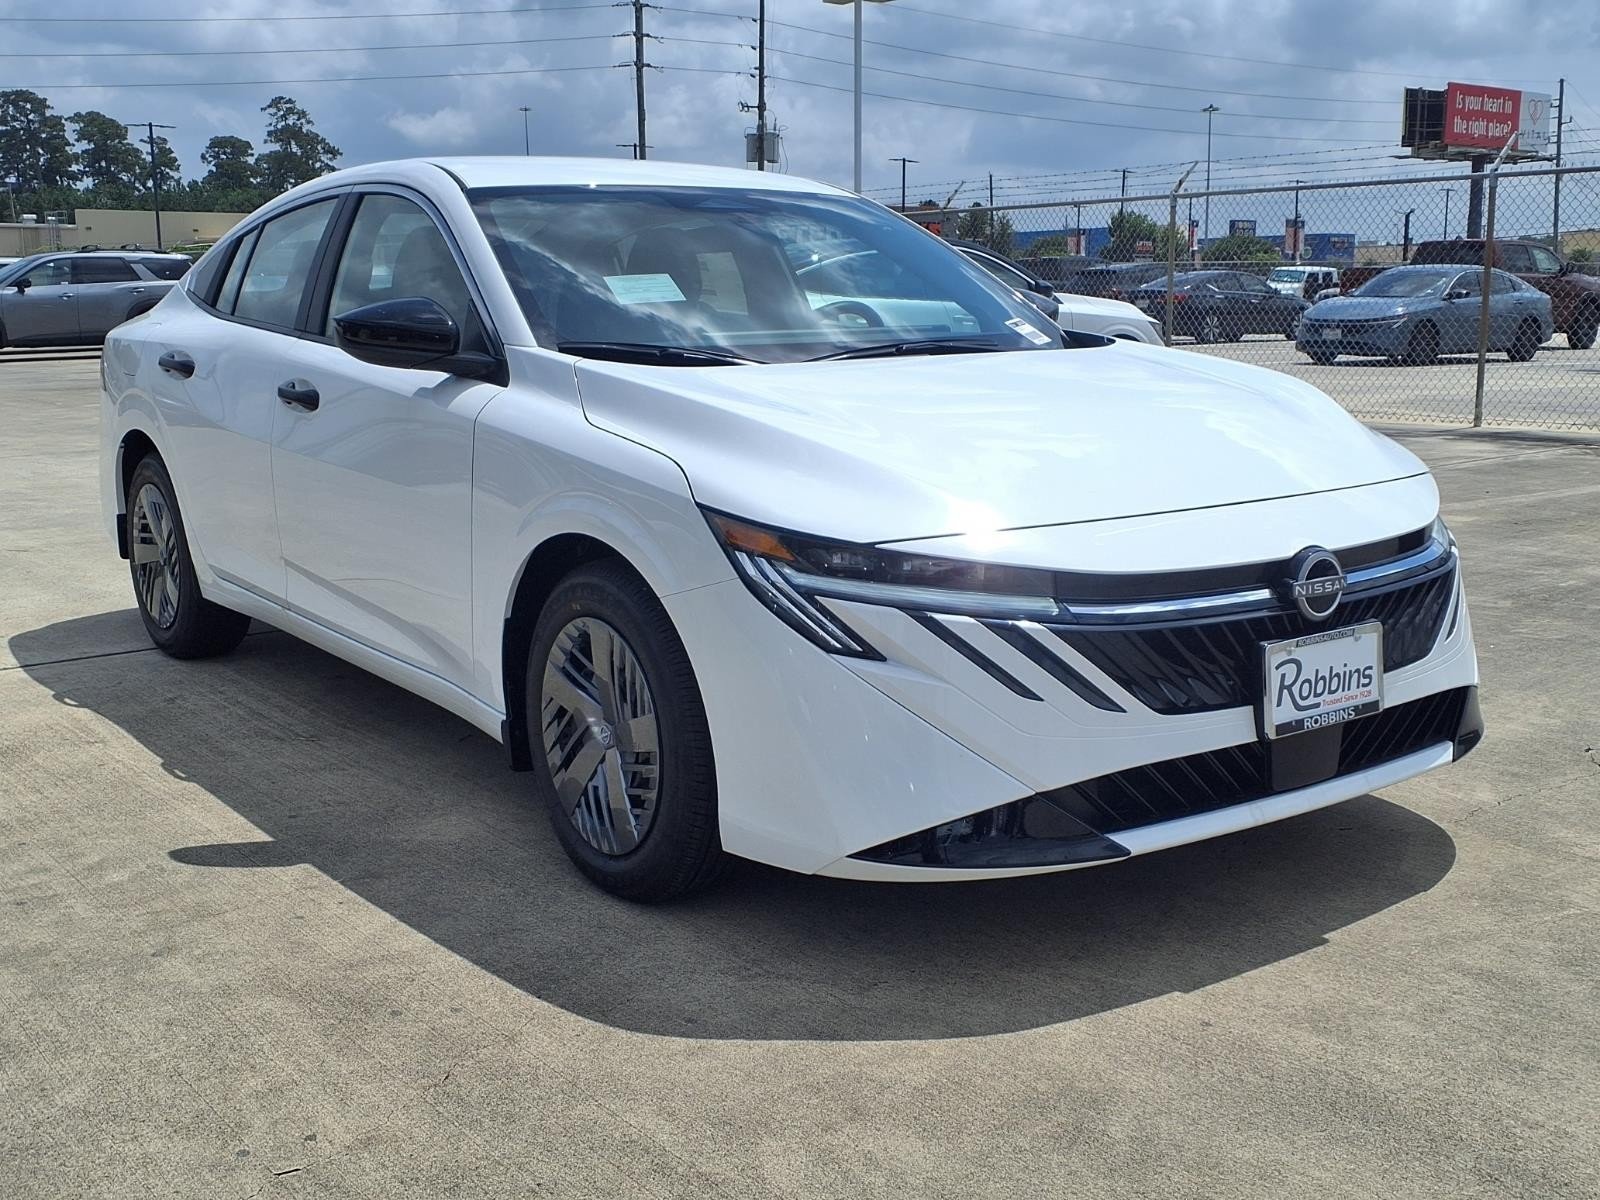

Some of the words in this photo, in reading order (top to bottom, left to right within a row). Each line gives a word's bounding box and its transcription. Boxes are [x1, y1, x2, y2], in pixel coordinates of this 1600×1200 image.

[1456, 90, 1463, 109] Is
[1465, 95, 1482, 112] your
[1483, 93, 1503, 113] heart
[1504, 96, 1512, 114] in
[1454, 115, 1467, 134] the
[1468, 116, 1487, 138] right
[1488, 119, 1511, 139] place?
[1295, 579, 1347, 596] NISSAN
[1275, 658, 1373, 712] Robbins
[1322, 696, 1343, 707] Trusted
[1343, 693, 1359, 703] Since
[1360, 688, 1373, 699] 1928
[1304, 707, 1355, 729] ROBBINS
